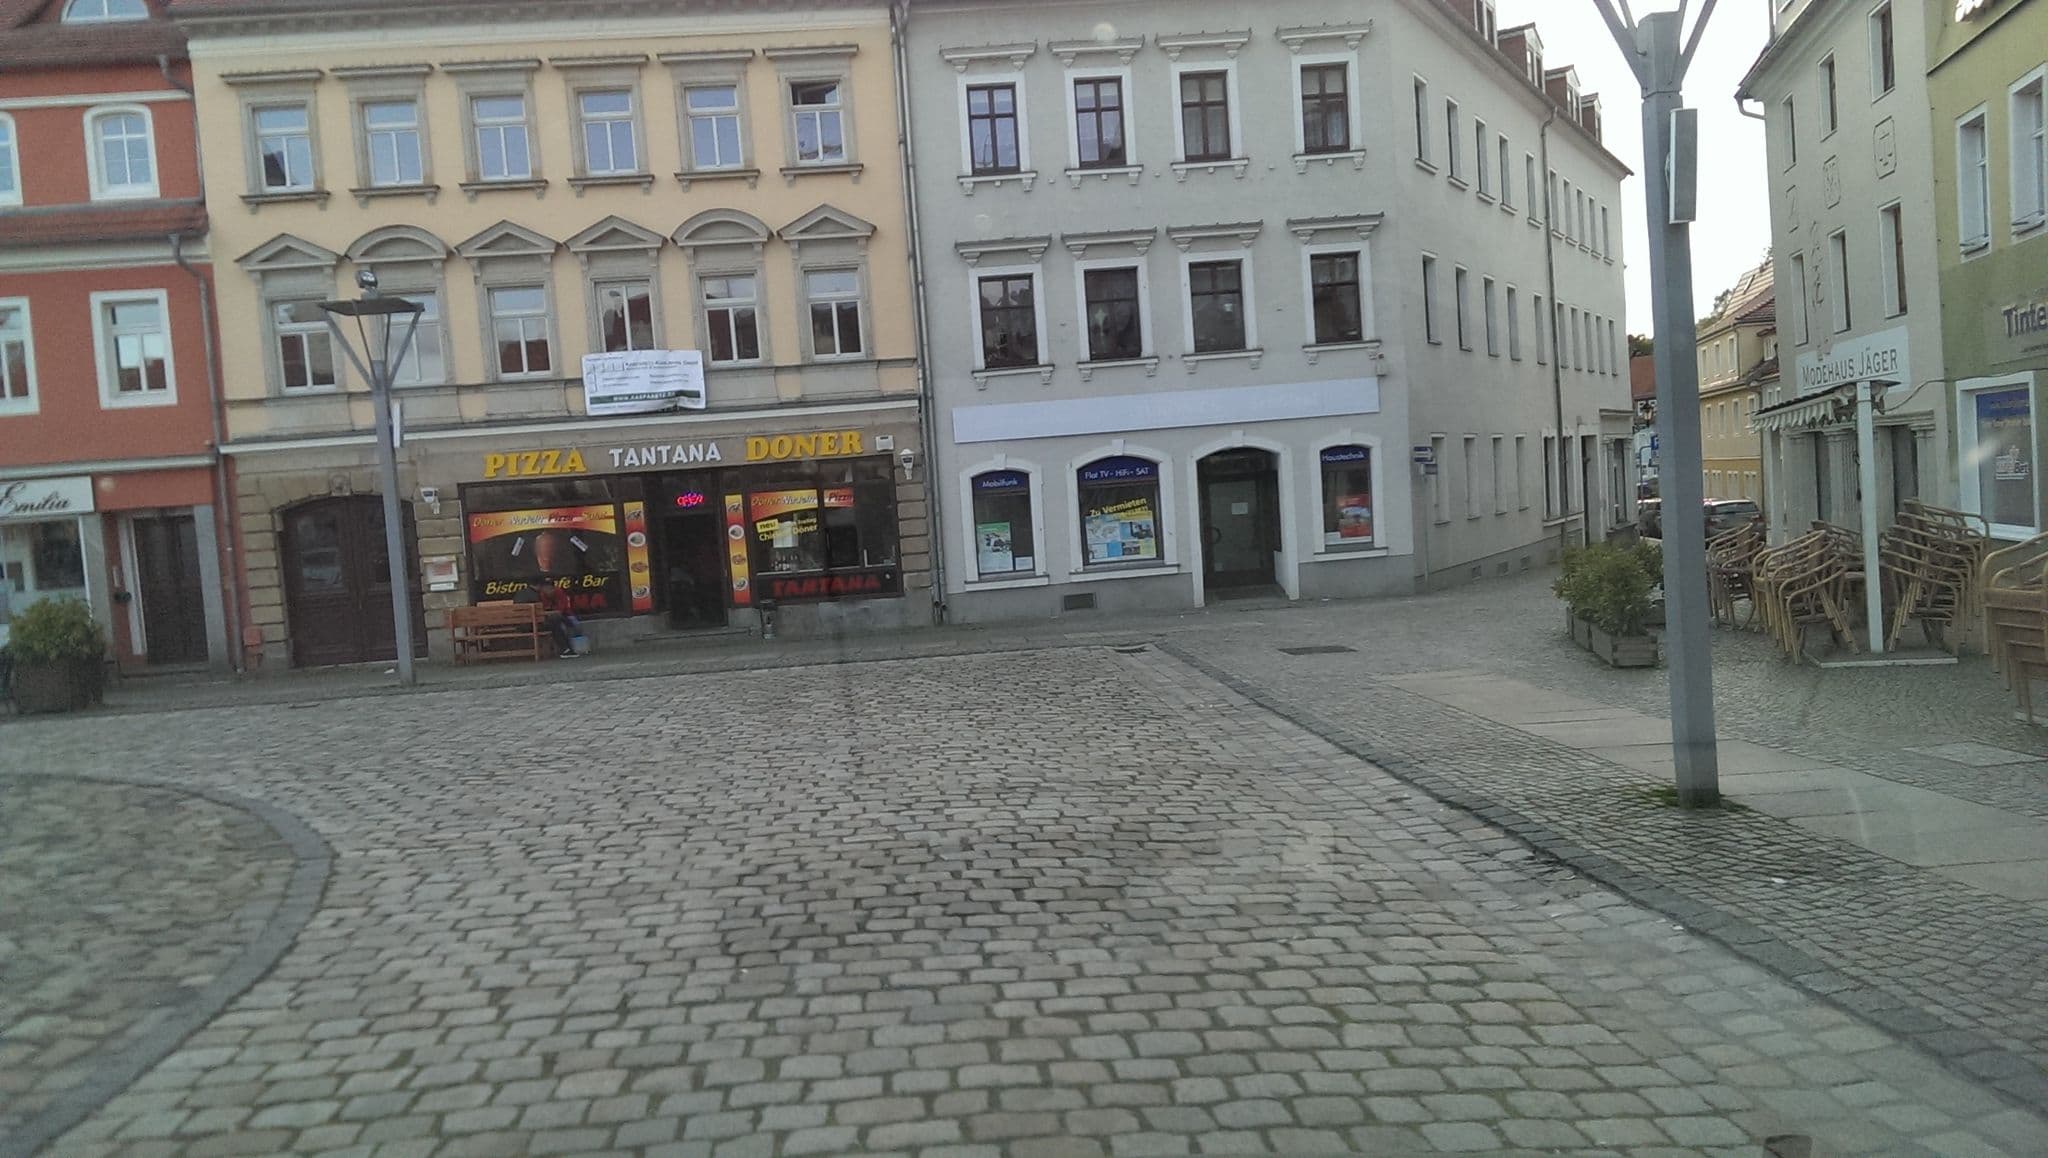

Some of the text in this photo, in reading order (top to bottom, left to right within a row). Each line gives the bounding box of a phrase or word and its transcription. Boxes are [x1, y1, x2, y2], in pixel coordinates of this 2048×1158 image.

[1802, 346, 1898, 385] MODEHAUS JÄGER
[484, 448, 587, 478] PIZZA
[608, 442, 722, 467] TANTANA
[1100, 470, 1109, 478] TV
[1135, 467, 1150, 476] SAT
[1089, 509, 1101, 517] Zu
[1102, 498, 1147, 513] Vermieten
[582, 574, 609, 587] Bar
